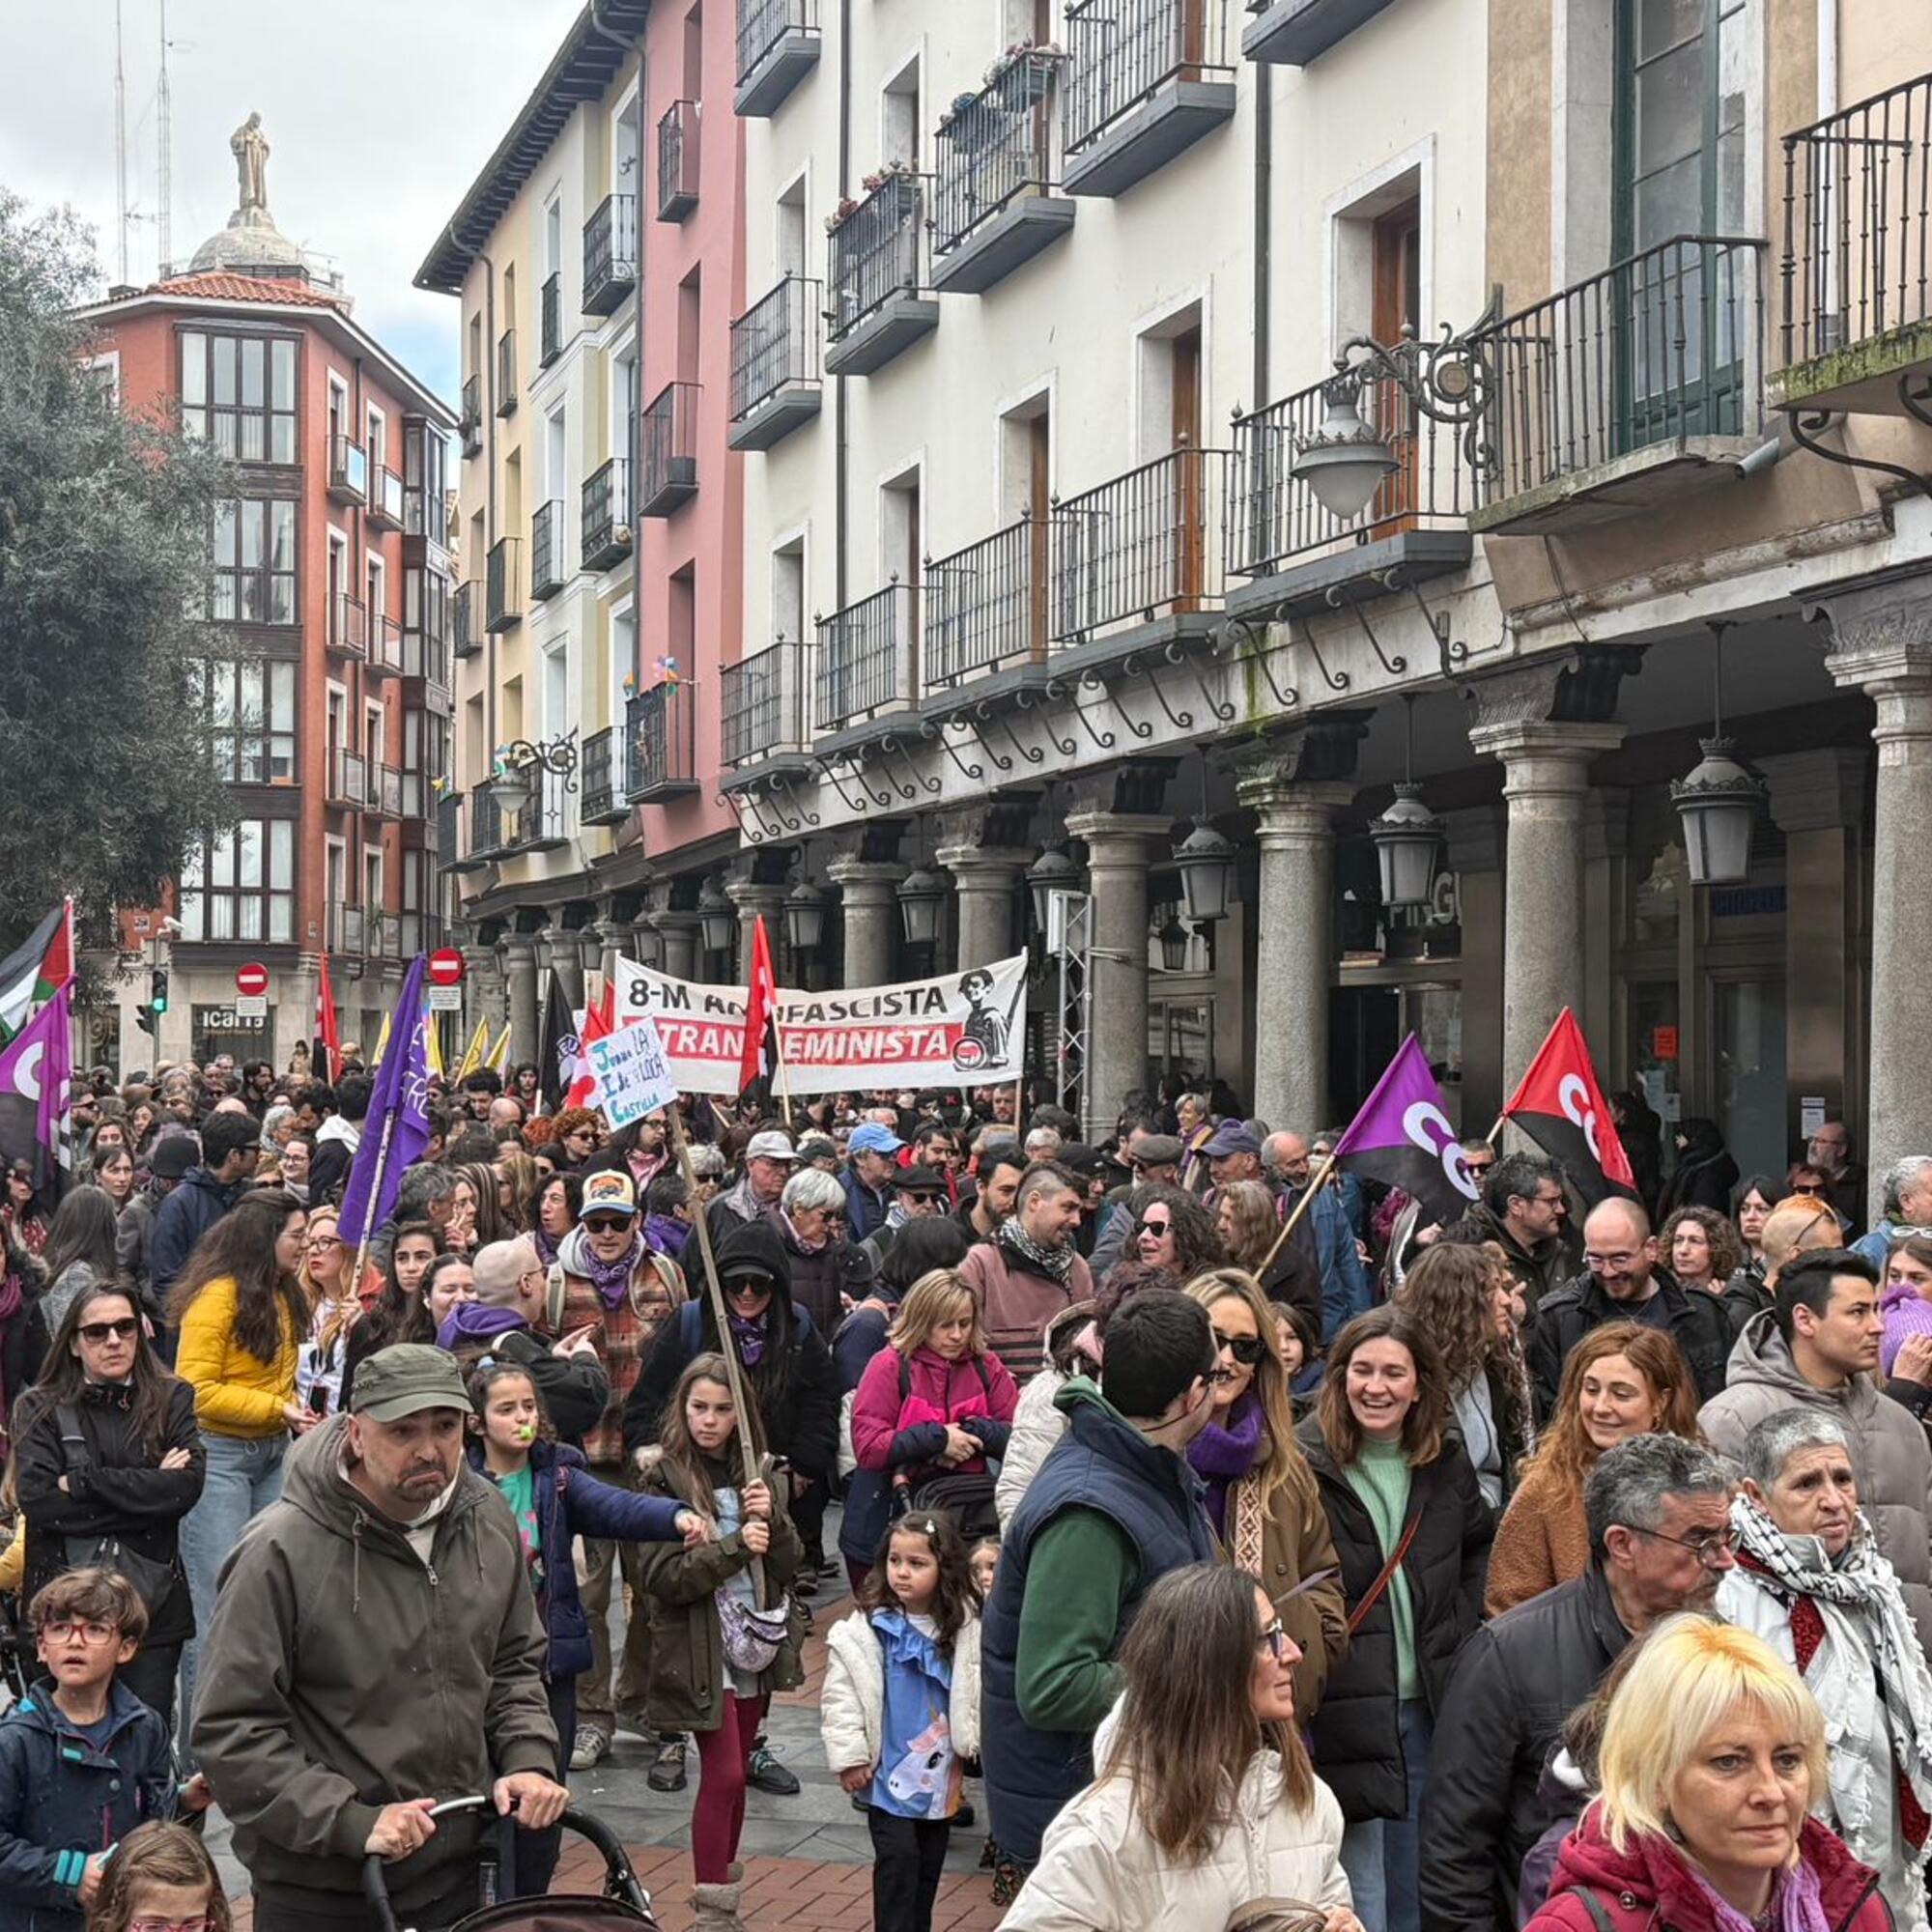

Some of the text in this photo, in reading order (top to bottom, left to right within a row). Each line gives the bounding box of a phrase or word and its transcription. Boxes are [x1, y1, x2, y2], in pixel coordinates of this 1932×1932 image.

[629, 979, 948, 1023] 8-M ANIFASCISTA
[660, 1025, 948, 1061] TRANEMINISTA
